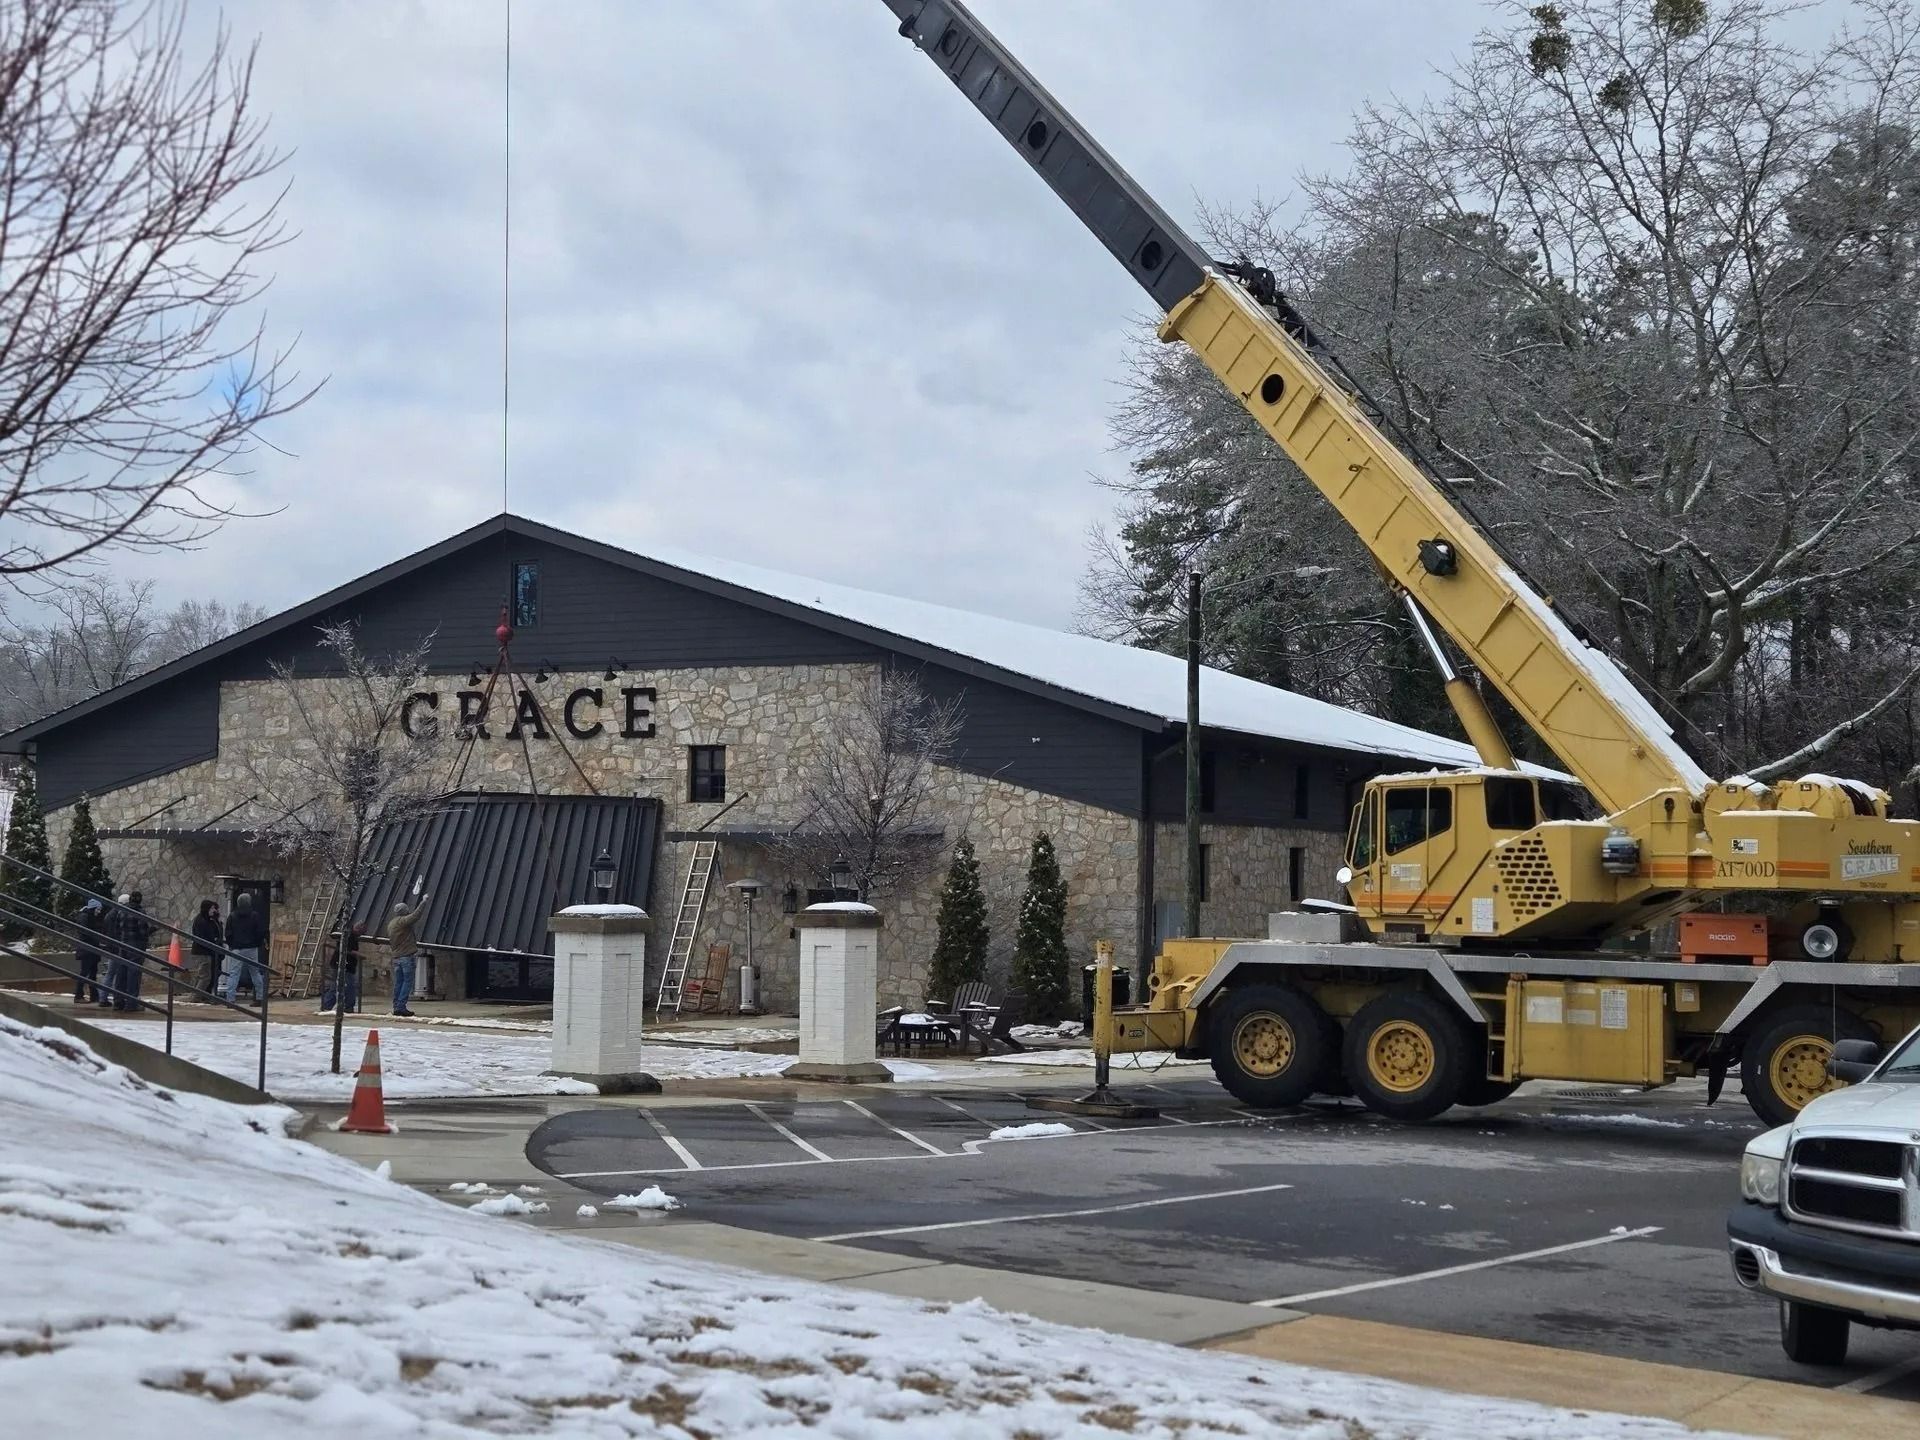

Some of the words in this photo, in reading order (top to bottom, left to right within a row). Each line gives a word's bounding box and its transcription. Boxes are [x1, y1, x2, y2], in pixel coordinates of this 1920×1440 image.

[401, 687, 656, 740] GRACE
[1848, 839, 1892, 855] Southern
[1717, 861, 1775, 877] AT700D
[1844, 857, 1897, 875] CRANE
